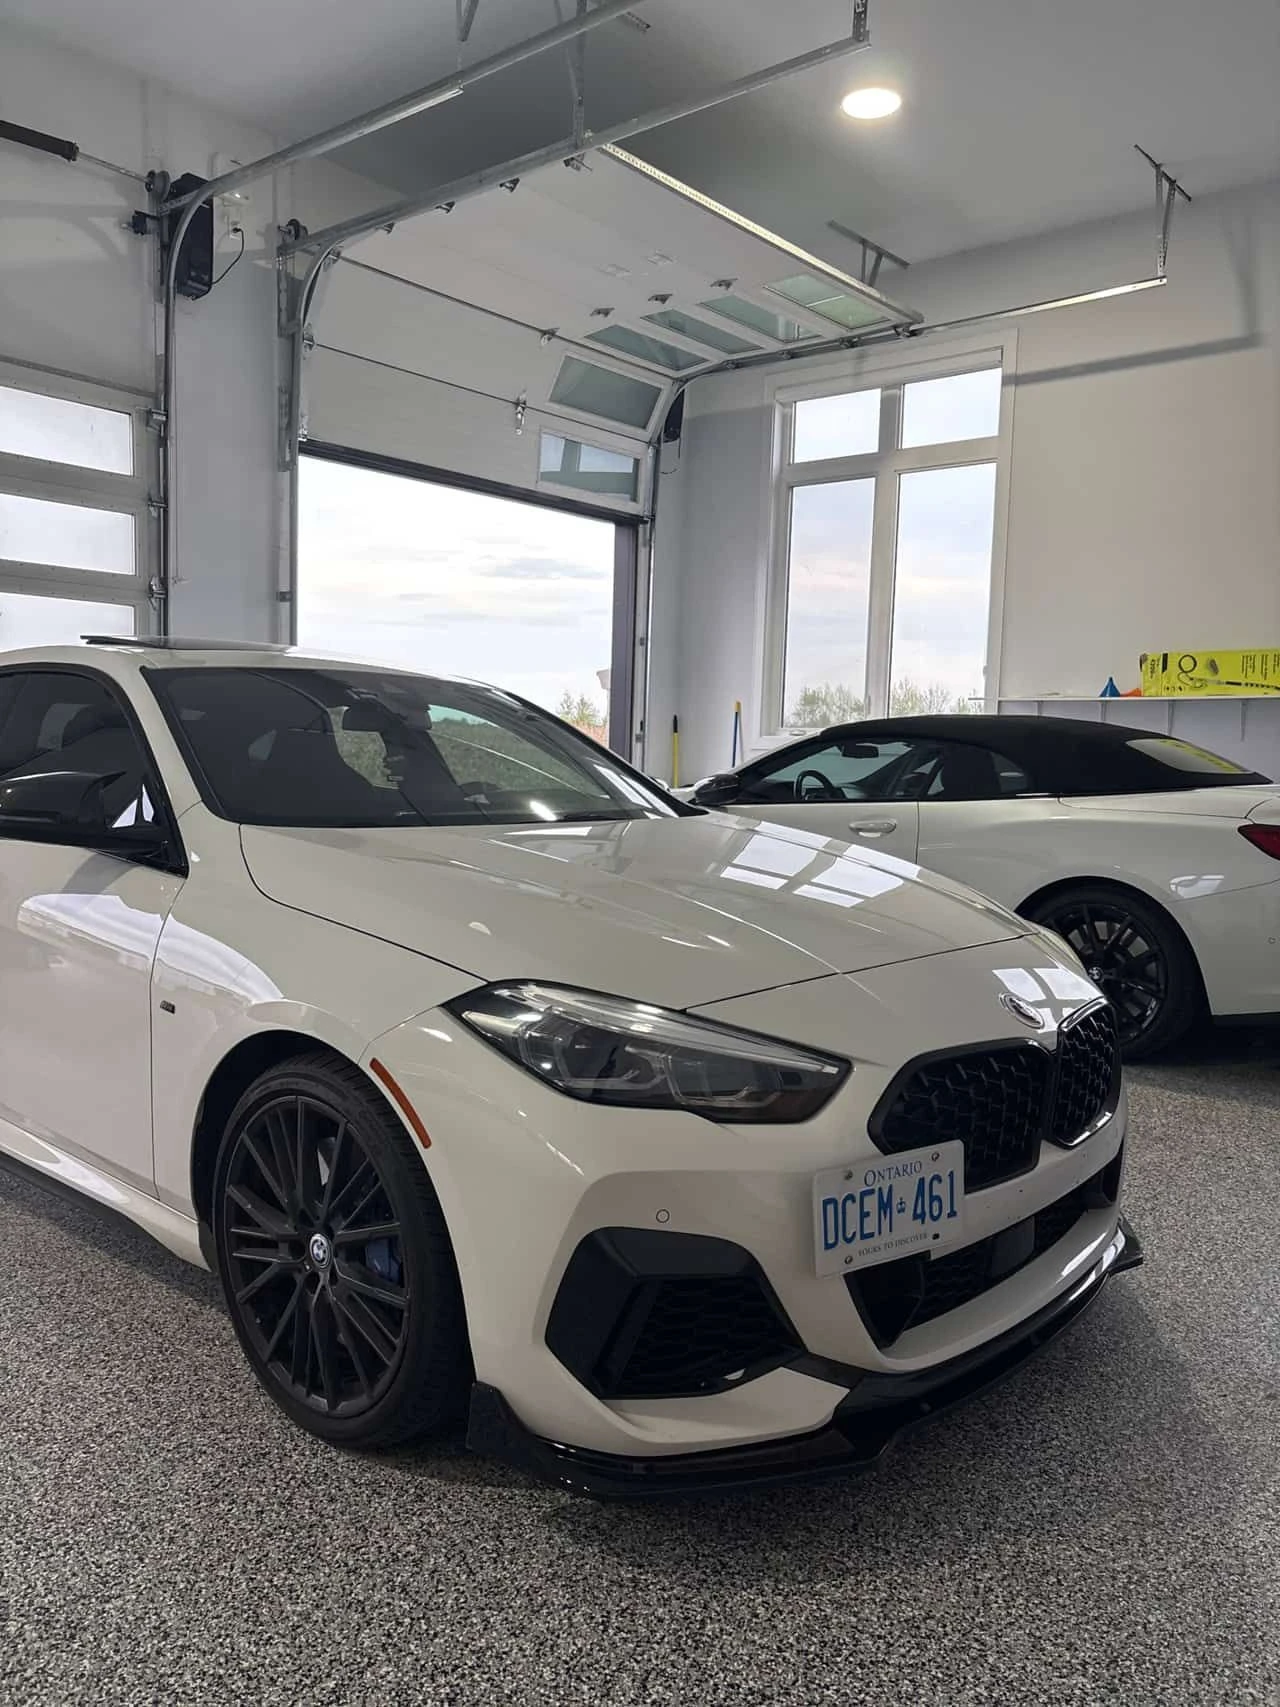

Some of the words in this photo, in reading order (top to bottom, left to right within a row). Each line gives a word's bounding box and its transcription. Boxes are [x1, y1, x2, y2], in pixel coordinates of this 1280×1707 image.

[864, 1160, 922, 1187] ONTARIO
[822, 1184, 893, 1251] DCEM
[912, 1170, 957, 1224] 461
[858, 1246, 882, 1257] YOURS
[884, 1241, 894, 1251] TO
[895, 1233, 928, 1248] DISCOVER
